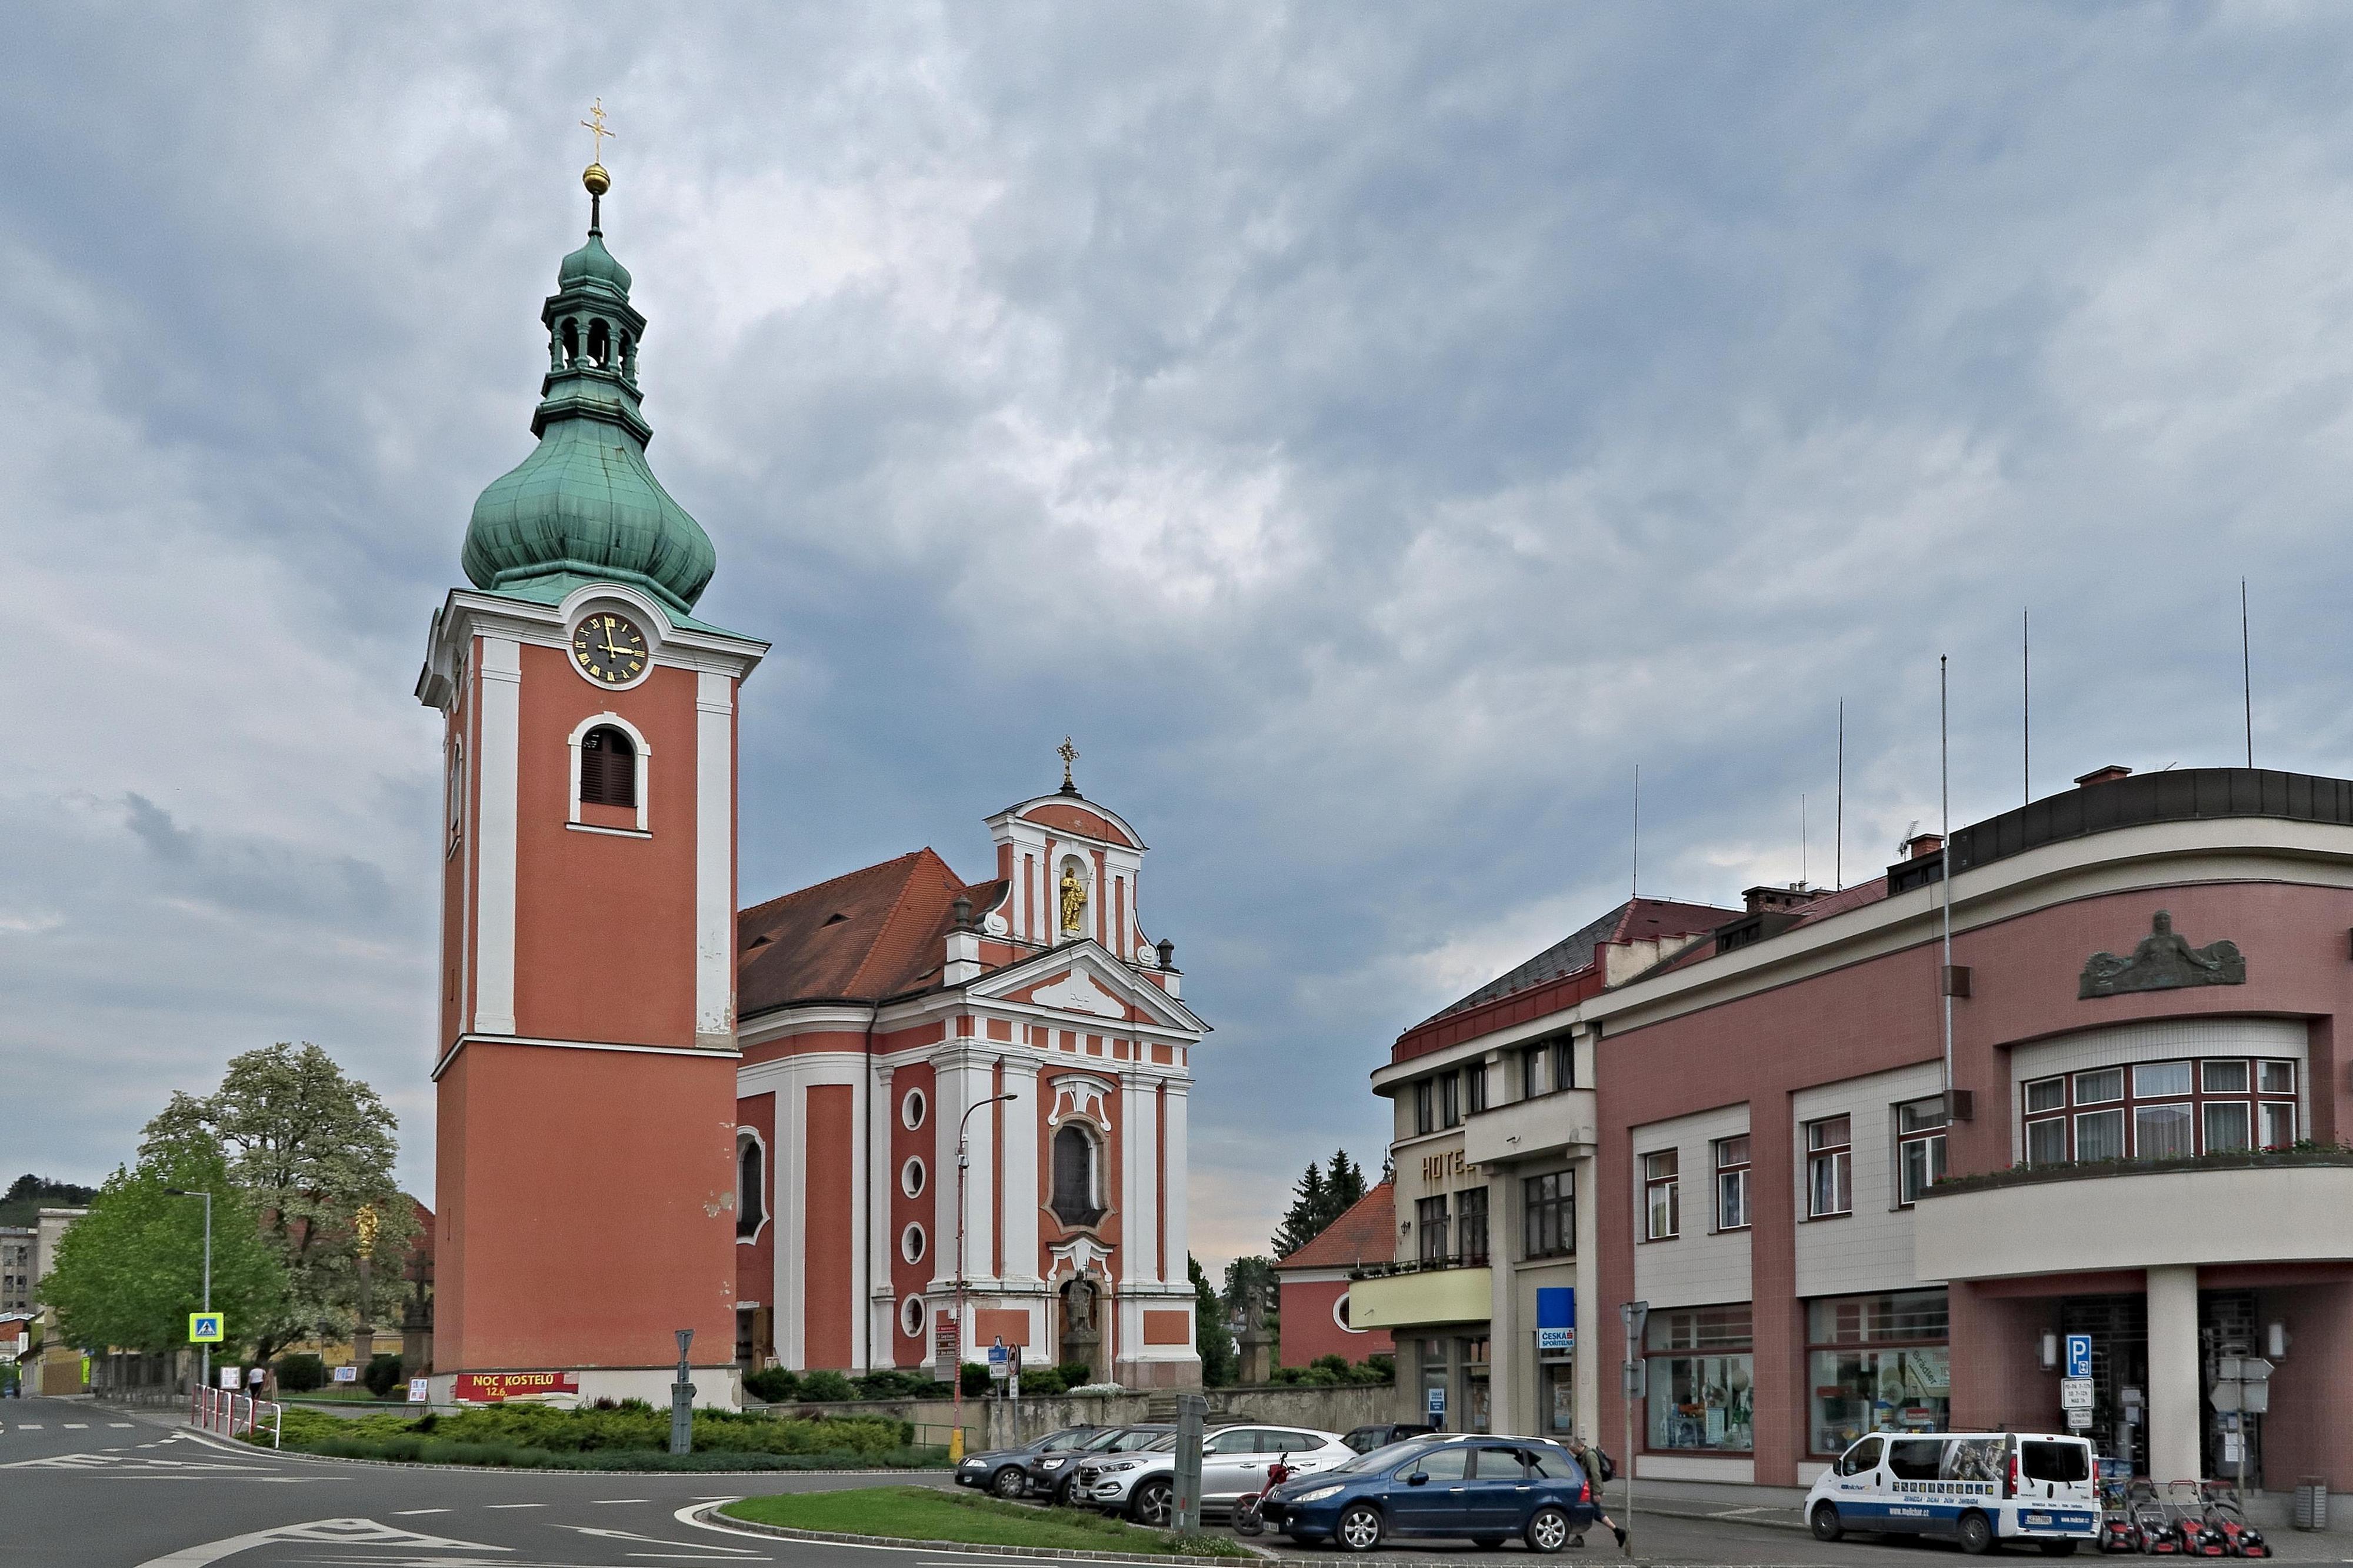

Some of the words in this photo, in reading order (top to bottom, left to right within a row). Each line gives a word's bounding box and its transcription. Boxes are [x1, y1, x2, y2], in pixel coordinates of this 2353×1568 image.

[579, 627, 591, 637] X
[621, 624, 628, 632] I
[621, 669, 630, 679] V
[1422, 1148, 1476, 1179] HOTE
[1542, 1331, 1567, 1340] ČESKÁ
[2072, 1340, 2087, 1364] P
[473, 1375, 499, 1386] NOC
[486, 1387, 508, 1397] 12.6.
